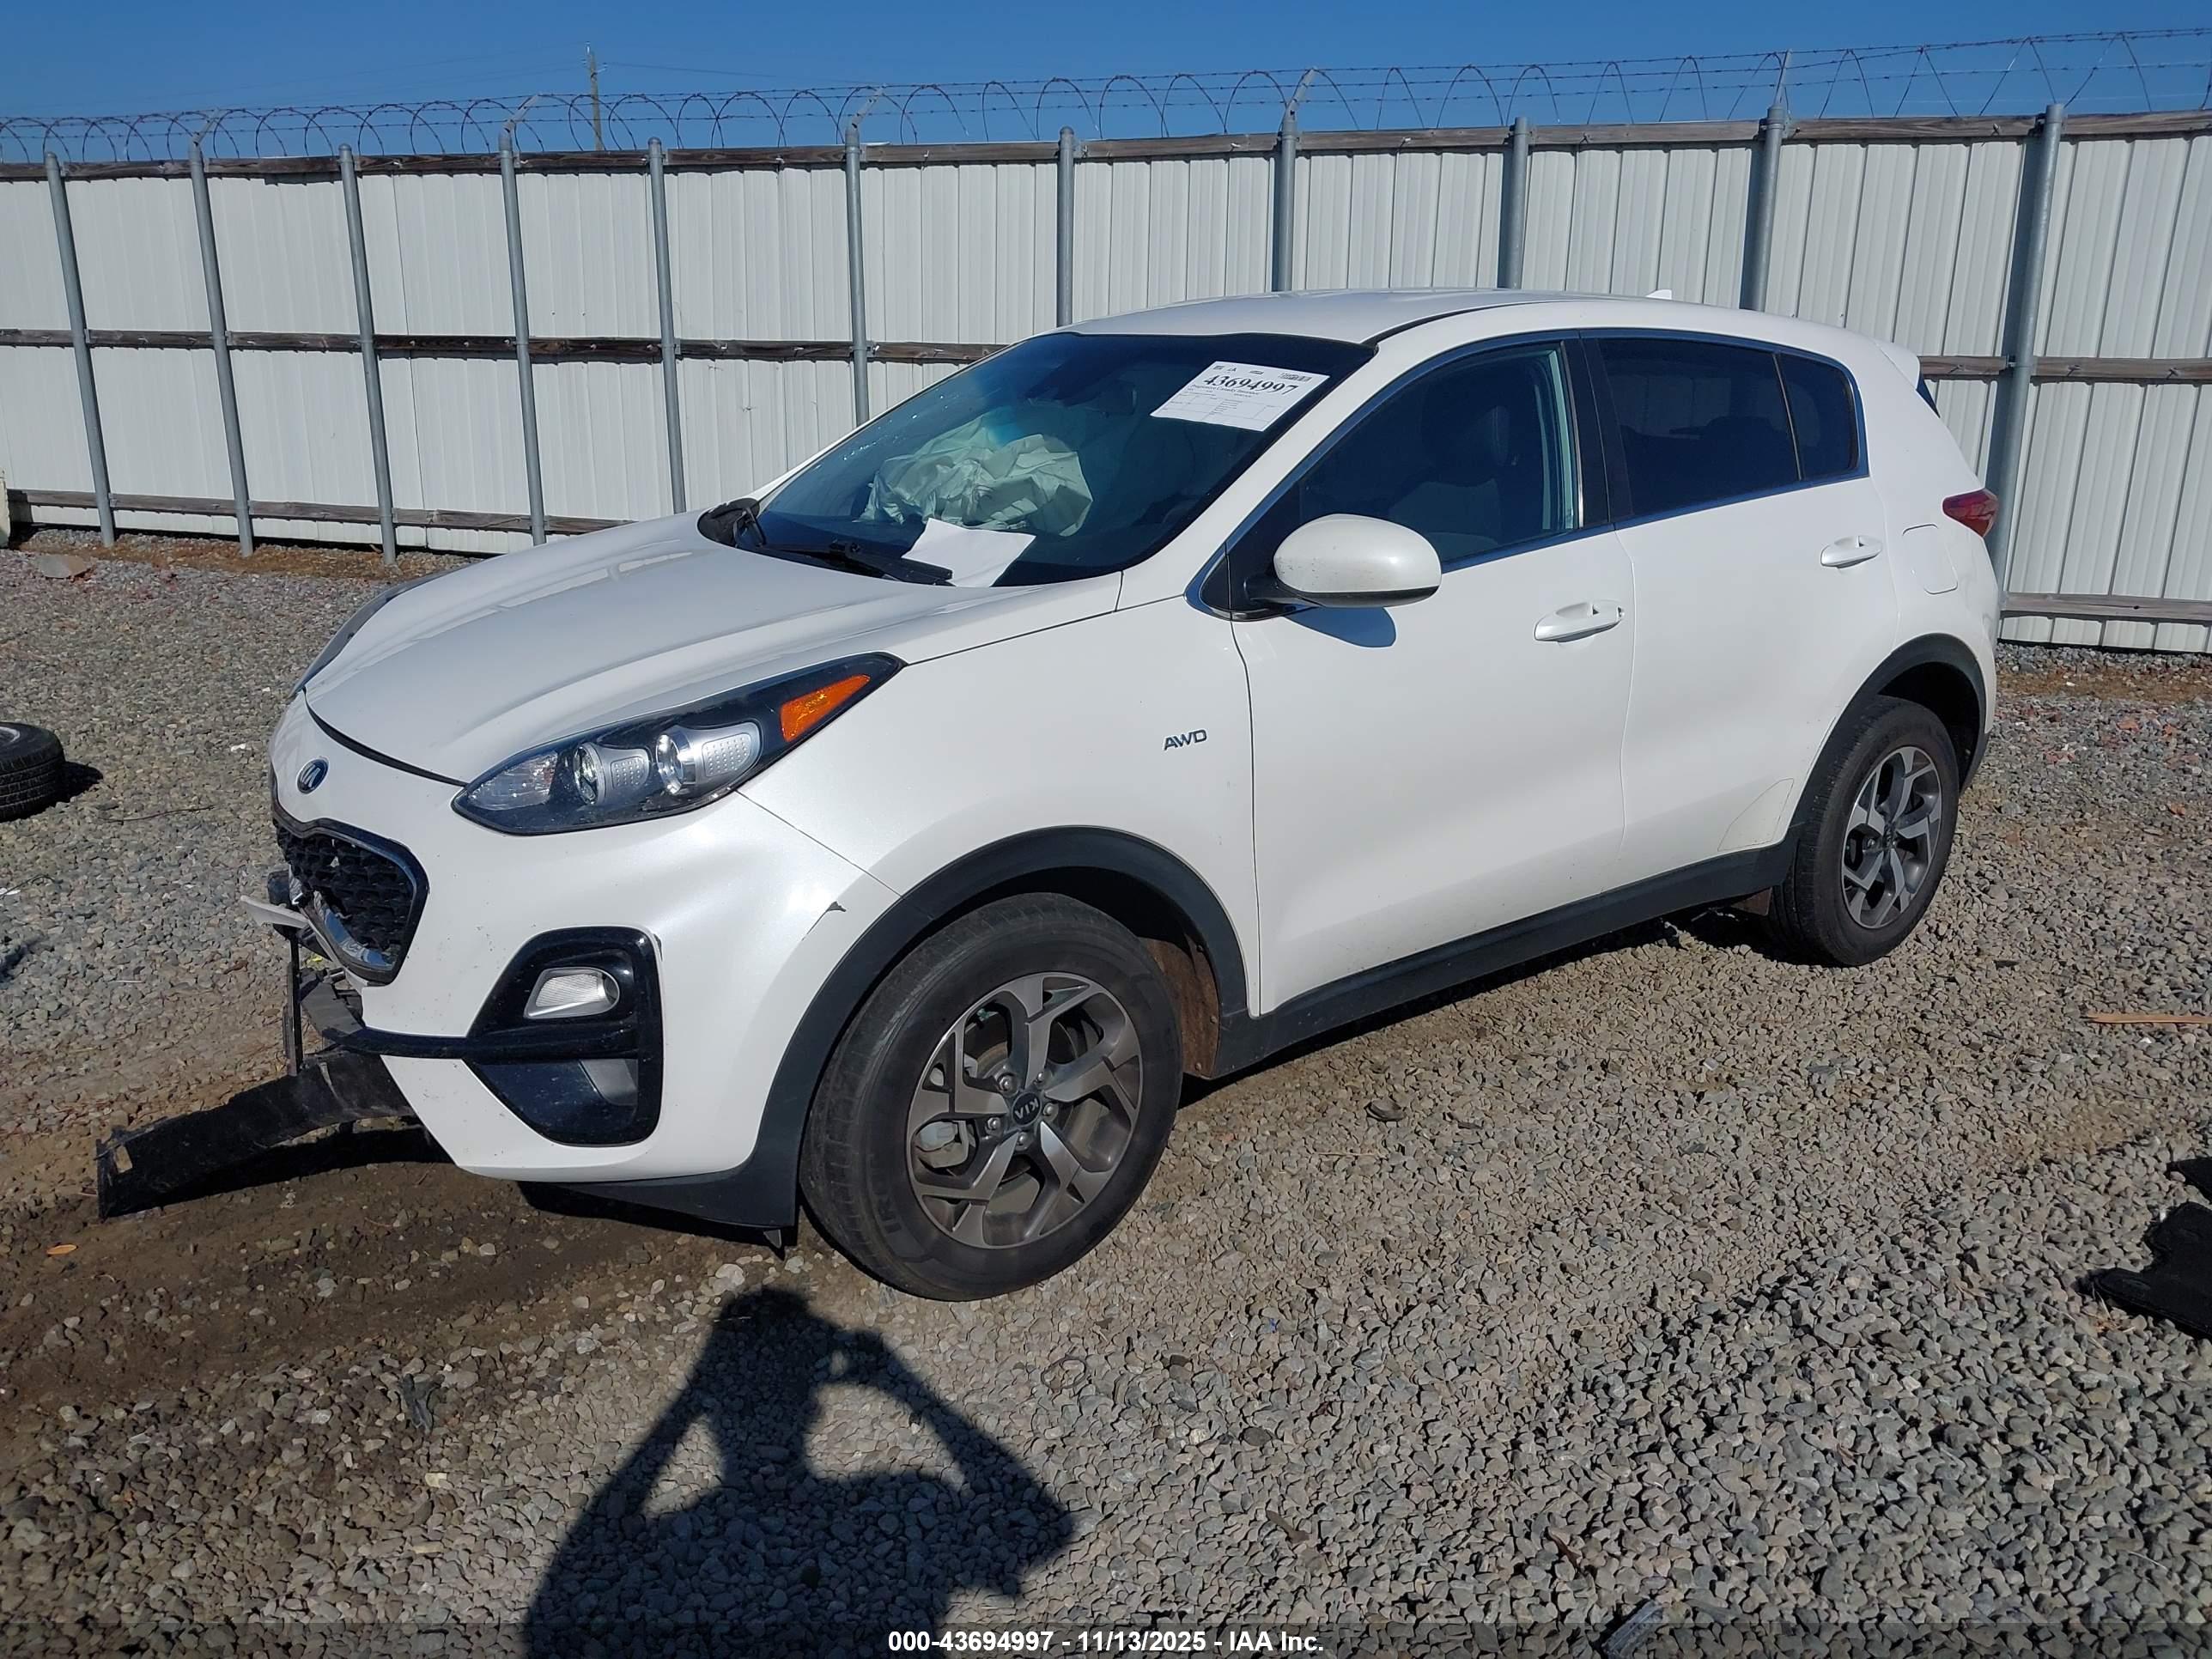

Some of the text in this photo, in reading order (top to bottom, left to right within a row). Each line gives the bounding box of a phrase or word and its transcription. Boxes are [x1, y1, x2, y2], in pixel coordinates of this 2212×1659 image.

[1204, 375, 1298, 395] 43694997
[1164, 729, 1207, 751] AWD
[1014, 1097, 1039, 1120] KIA
